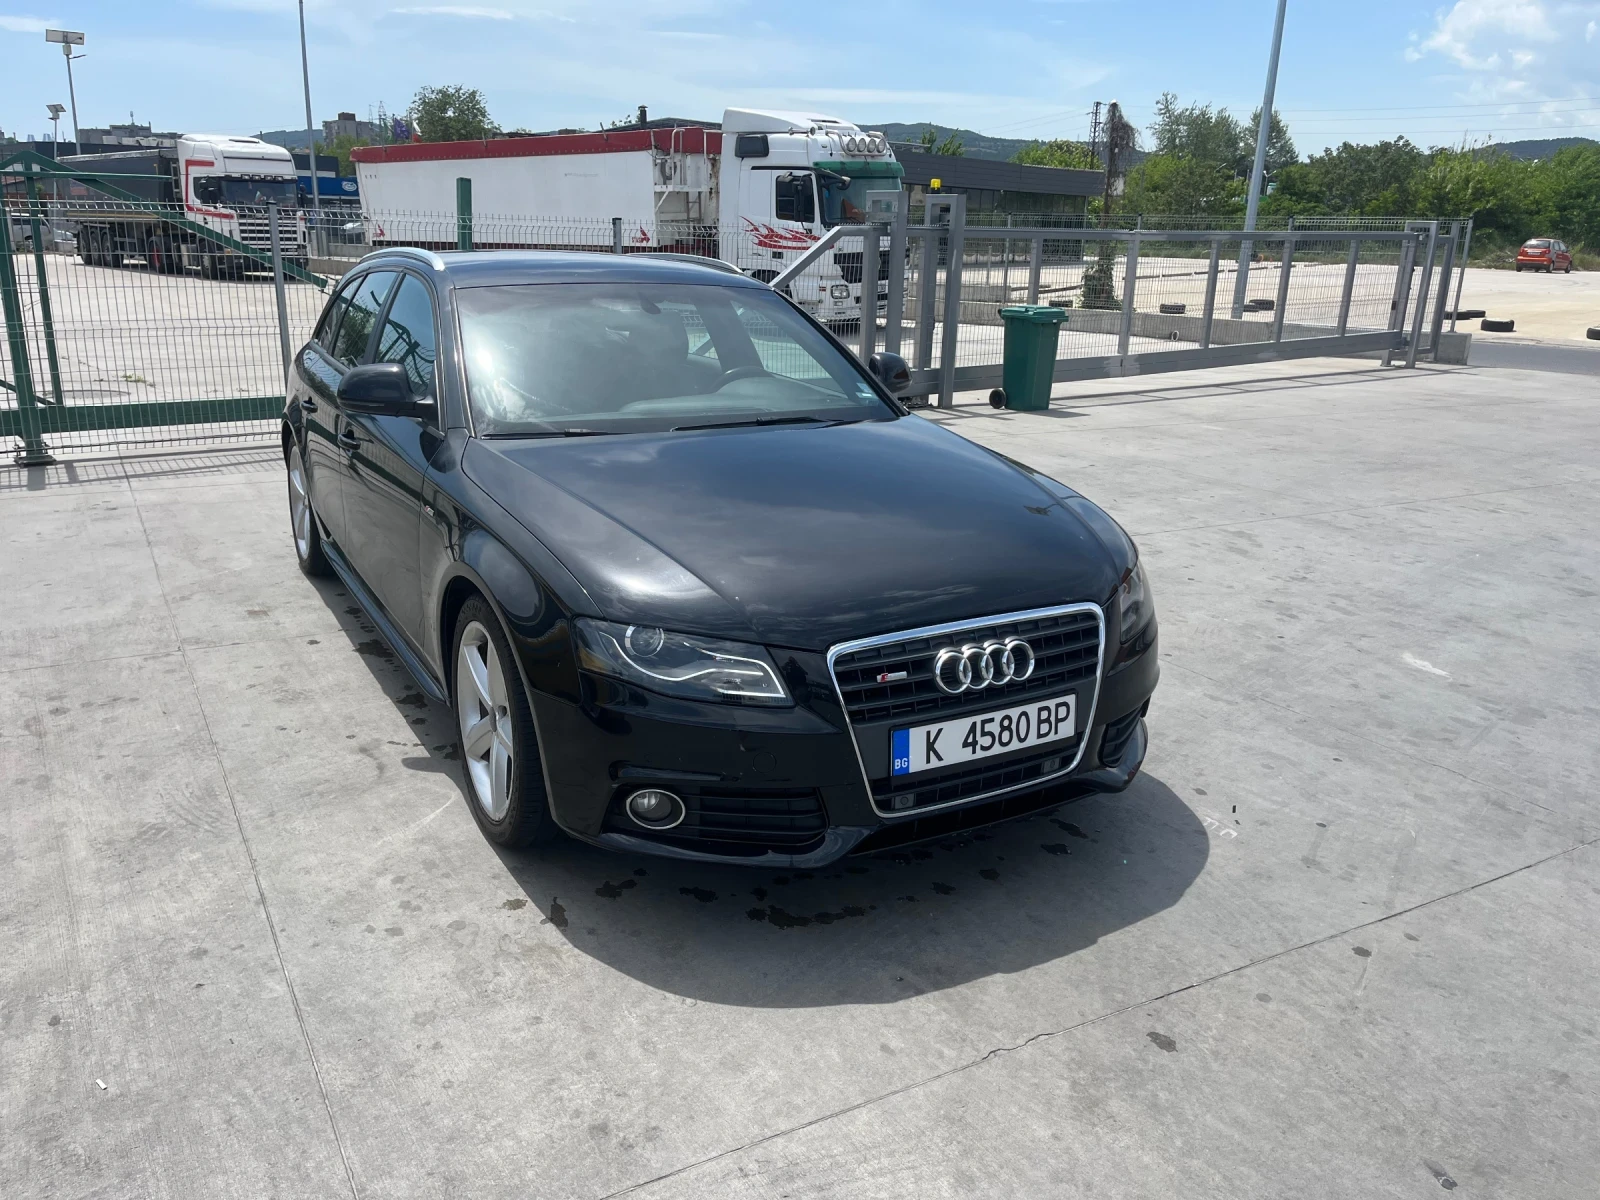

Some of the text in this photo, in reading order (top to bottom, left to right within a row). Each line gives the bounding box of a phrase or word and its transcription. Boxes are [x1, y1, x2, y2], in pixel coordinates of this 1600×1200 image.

[925, 701, 1071, 764] K 4580 BP
[894, 758, 909, 770] BG
